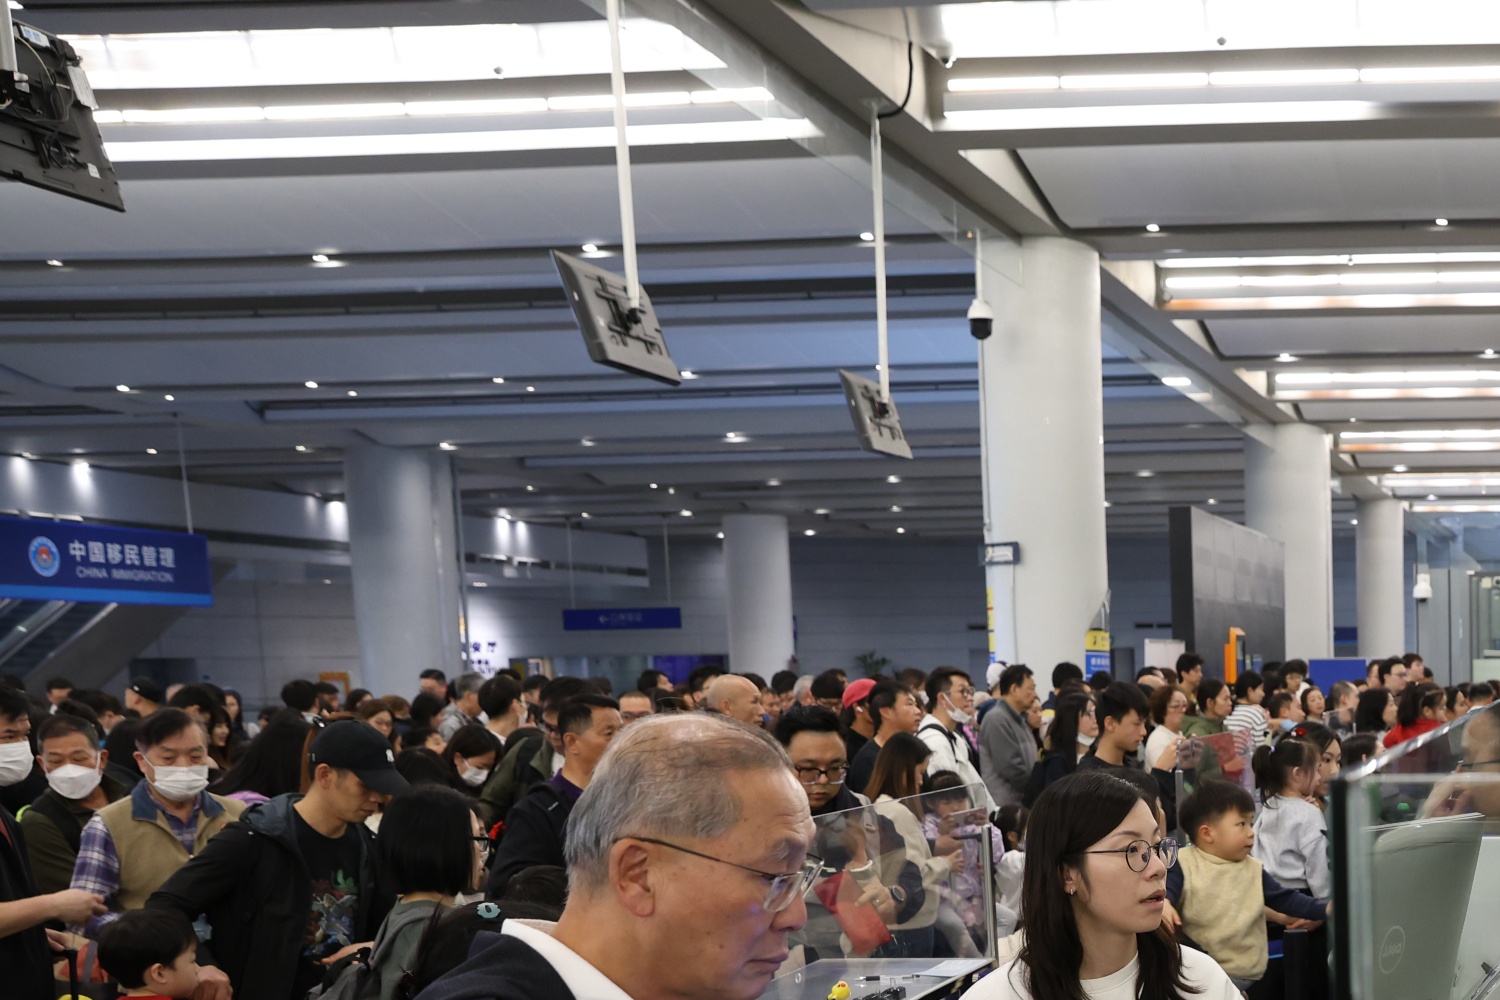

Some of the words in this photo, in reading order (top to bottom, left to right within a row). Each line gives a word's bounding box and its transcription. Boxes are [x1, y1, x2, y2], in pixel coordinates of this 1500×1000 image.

[68, 540, 175, 568] 中国移民管理
[76, 566, 108, 578] CHINA
[111, 568, 174, 583] IMMIGRATION
